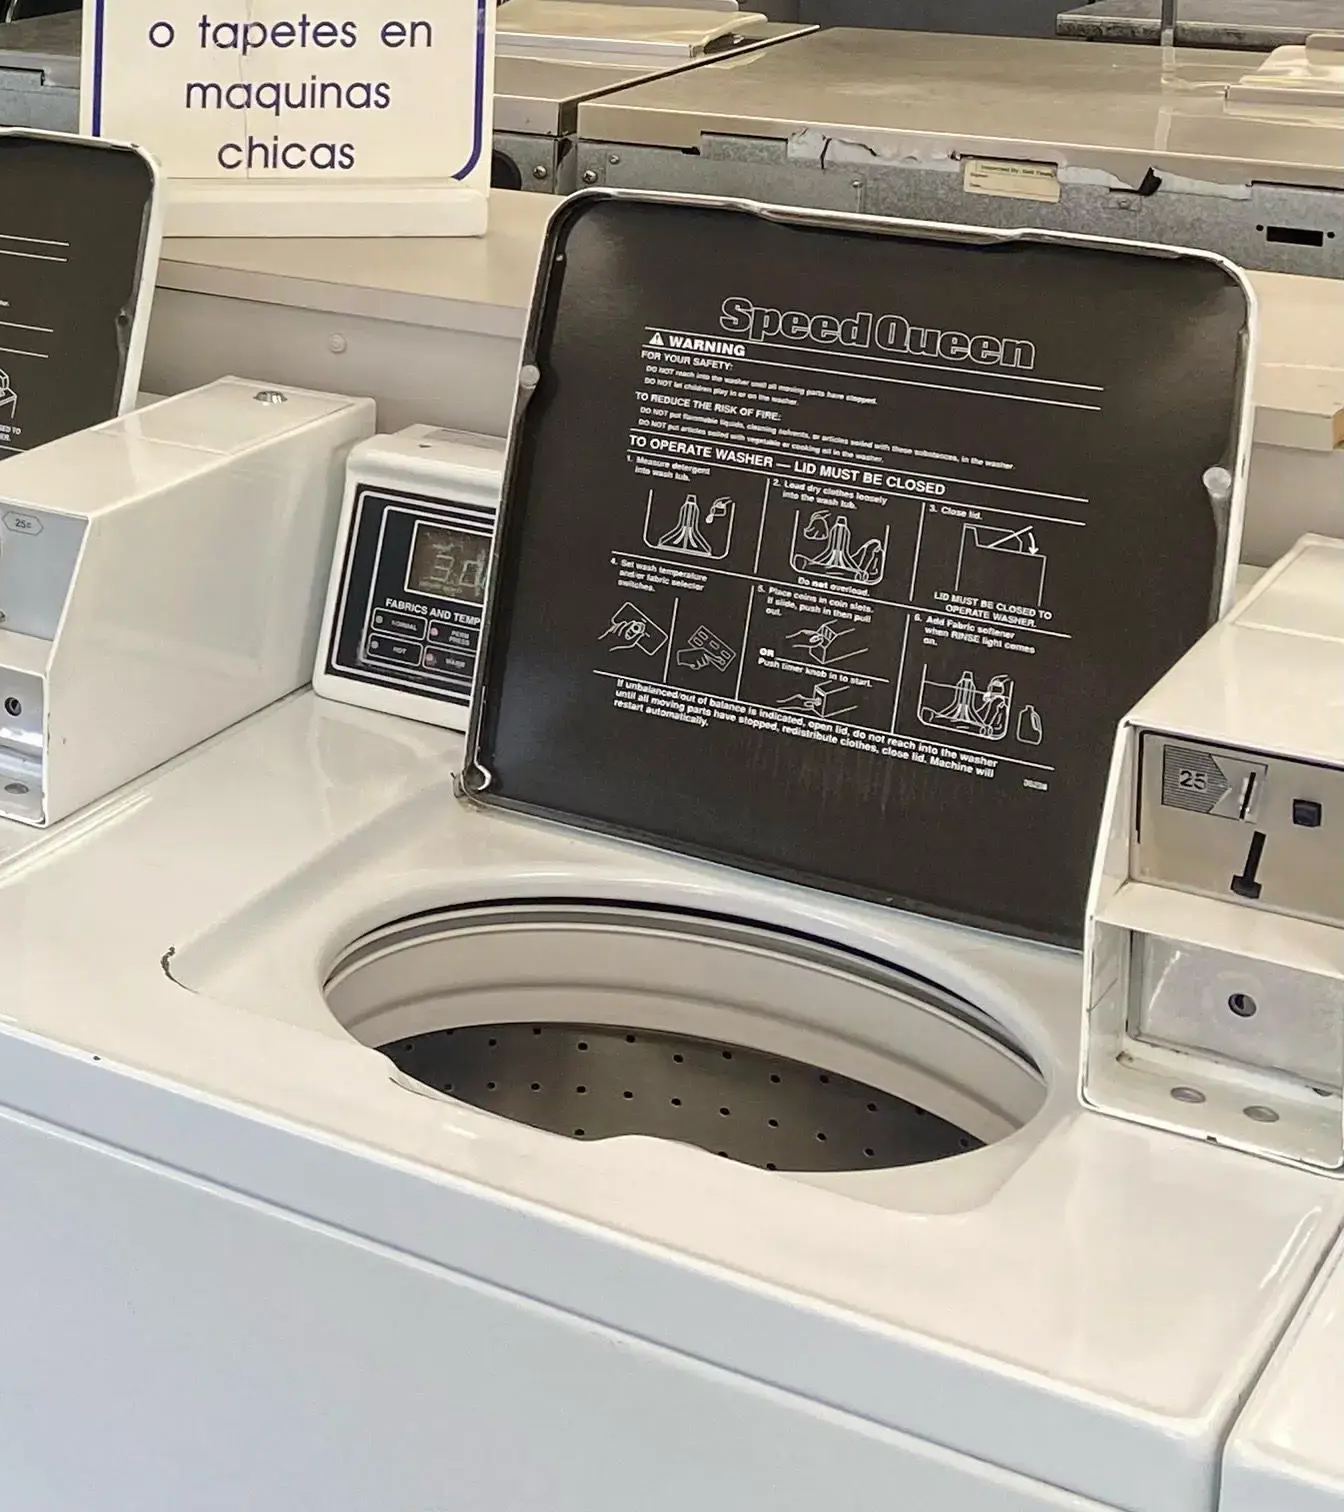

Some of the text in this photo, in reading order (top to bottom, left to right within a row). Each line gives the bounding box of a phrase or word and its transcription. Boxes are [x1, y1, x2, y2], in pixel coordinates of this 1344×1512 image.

[149, 14, 433, 55] o tapetes en
[186, 75, 390, 116] maquinas
[218, 136, 355, 169] chicas
[668, 335, 745, 356] WARNING
[719, 297, 1035, 370] Speed Queen
[640, 350, 733, 370] FOR YOUR SAFETY:
[634, 391, 781, 421] TO REDUCE THE RISK OF FIRE:
[629, 434, 945, 495] TO OPERATE WASHER LID MUST BE CLOSED
[385, 597, 428, 616] FABRICS
[431, 607, 451, 620] AND
[933, 591, 1052, 619] LID MUST BE CLOSED TO
[945, 603, 1036, 627] OPERATE WASHER.
[393, 645, 407, 655] HOT
[613, 699, 708, 727] restart automatically.
[616, 678, 998, 767] If unbalanced/out of balance is indicated, open lid, do not reach into the washer
[615, 690, 994, 777] until all moving parts have stopped, redistribute clothes, close lid. Machine will
[1180, 770, 1207, 790] 25
